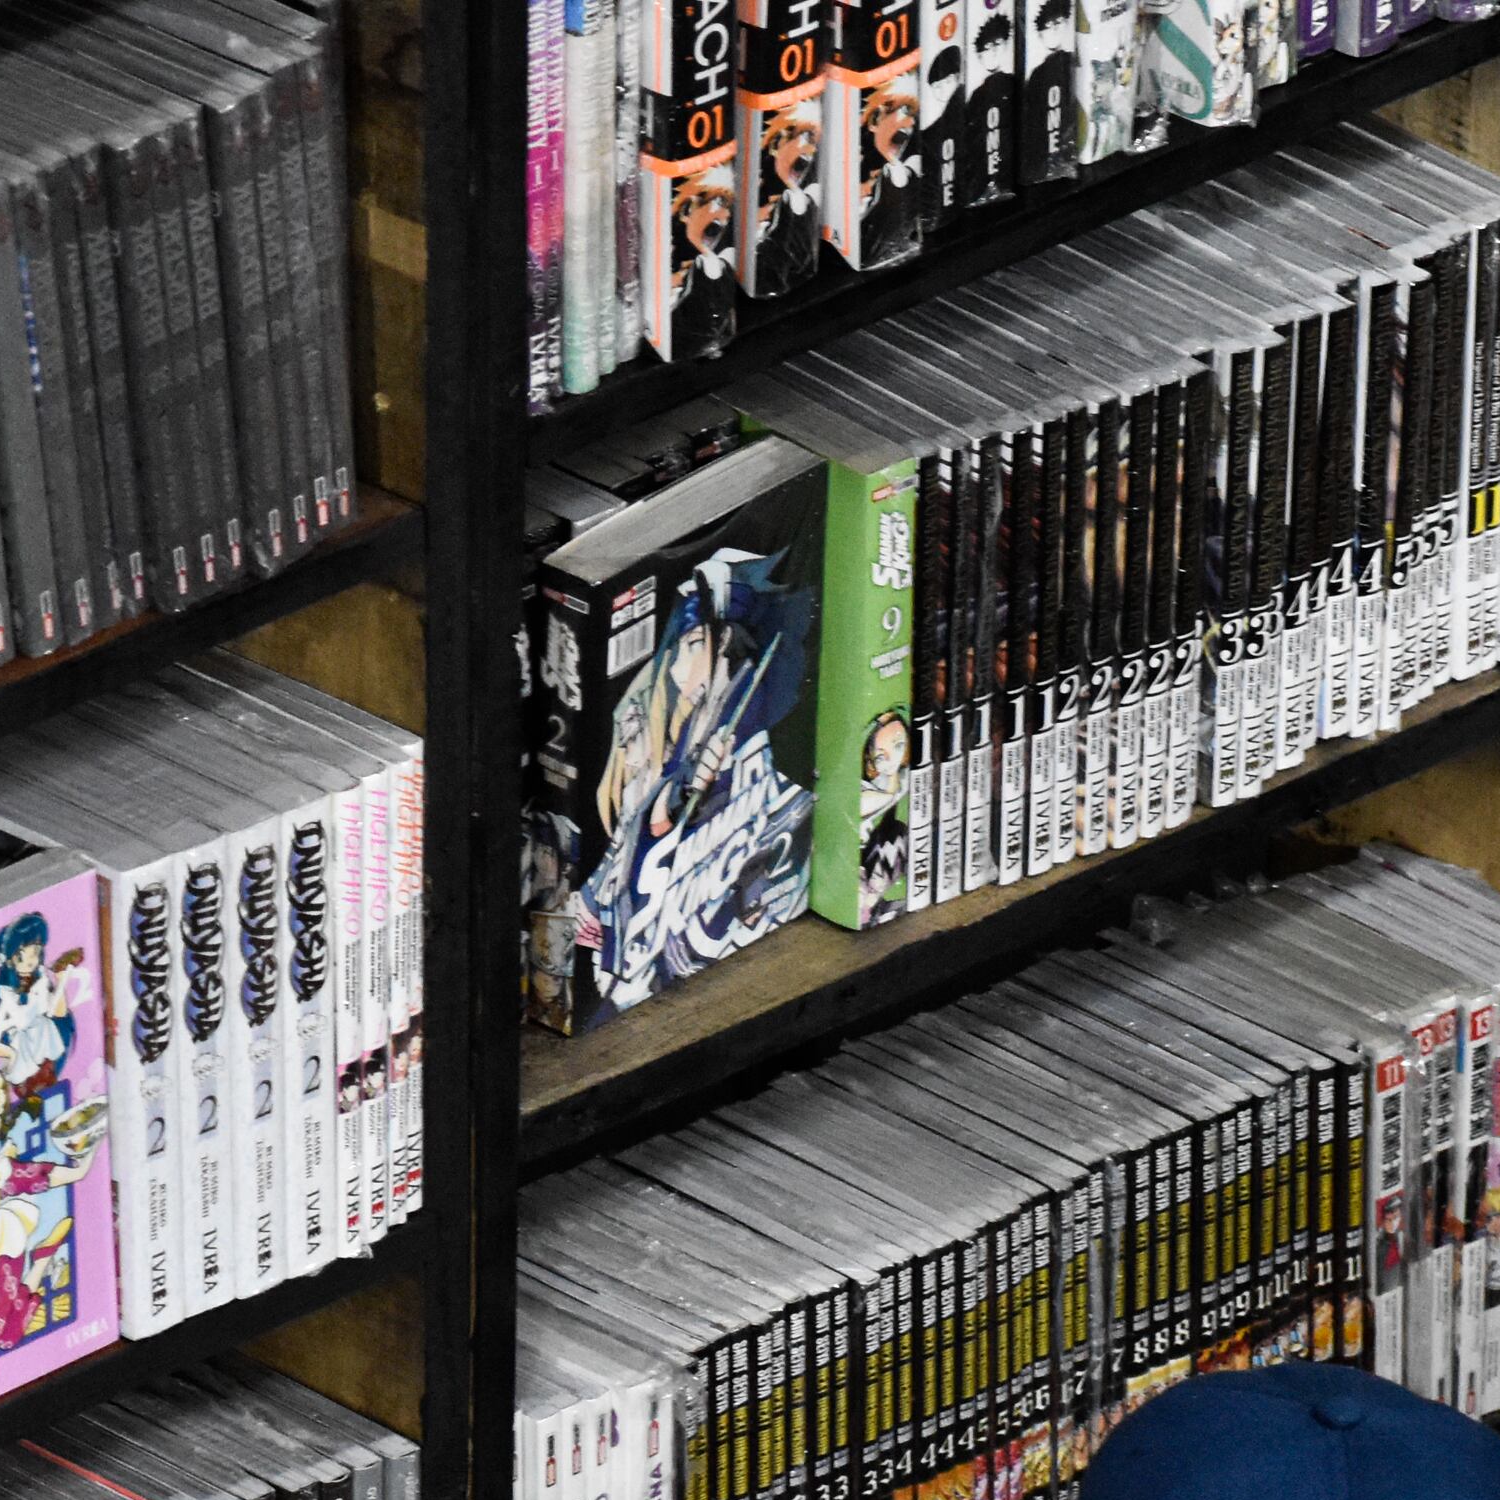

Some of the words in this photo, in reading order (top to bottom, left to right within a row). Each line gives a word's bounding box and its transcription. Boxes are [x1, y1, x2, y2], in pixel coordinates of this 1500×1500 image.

[780, 38, 815, 82] 01
[874, 14, 910, 59] 01
[687, 104, 724, 149] 01
[986, 106, 1001, 175] ONE
[1047, 86, 1062, 154] ONE
[941, 138, 955, 206] ONE
[1329, 547, 1353, 593] 4
[1359, 547, 1383, 593] 4
[881, 606, 902, 643] 9
[1219, 617, 1244, 664] 3
[1247, 611, 1271, 658] 3
[1121, 658, 1145, 706] 2
[1148, 648, 1170, 695] 2
[1330, 661, 1348, 725] IVREA
[1357, 661, 1374, 725] IVREA
[549, 714, 567, 752] 2
[1218, 731, 1236, 795] IVREA
[1057, 787, 1075, 850] IVREA
[1119, 772, 1137, 834] IVREA
[767, 832, 793, 879] 2
[1005, 806, 1021, 870] IVREA
[238, 843, 278, 1029] INUYASHA
[285, 820, 328, 1005] INUYASHA
[128, 881, 173, 1065] INUYASHA
[180, 862, 226, 1045] INUYASHA
[198, 1095, 219, 1137] 2
[253, 1079, 274, 1120] 2
[146, 1116, 168, 1159] 2
[343, 1176, 361, 1244] IVREA
[369, 1162, 387, 1231] IVREA
[256, 1211, 273, 1279] IVREA
[150, 1250, 169, 1319] IVREA
[1175, 1318, 1190, 1346] 8
[833, 1474, 849, 1500] 3
